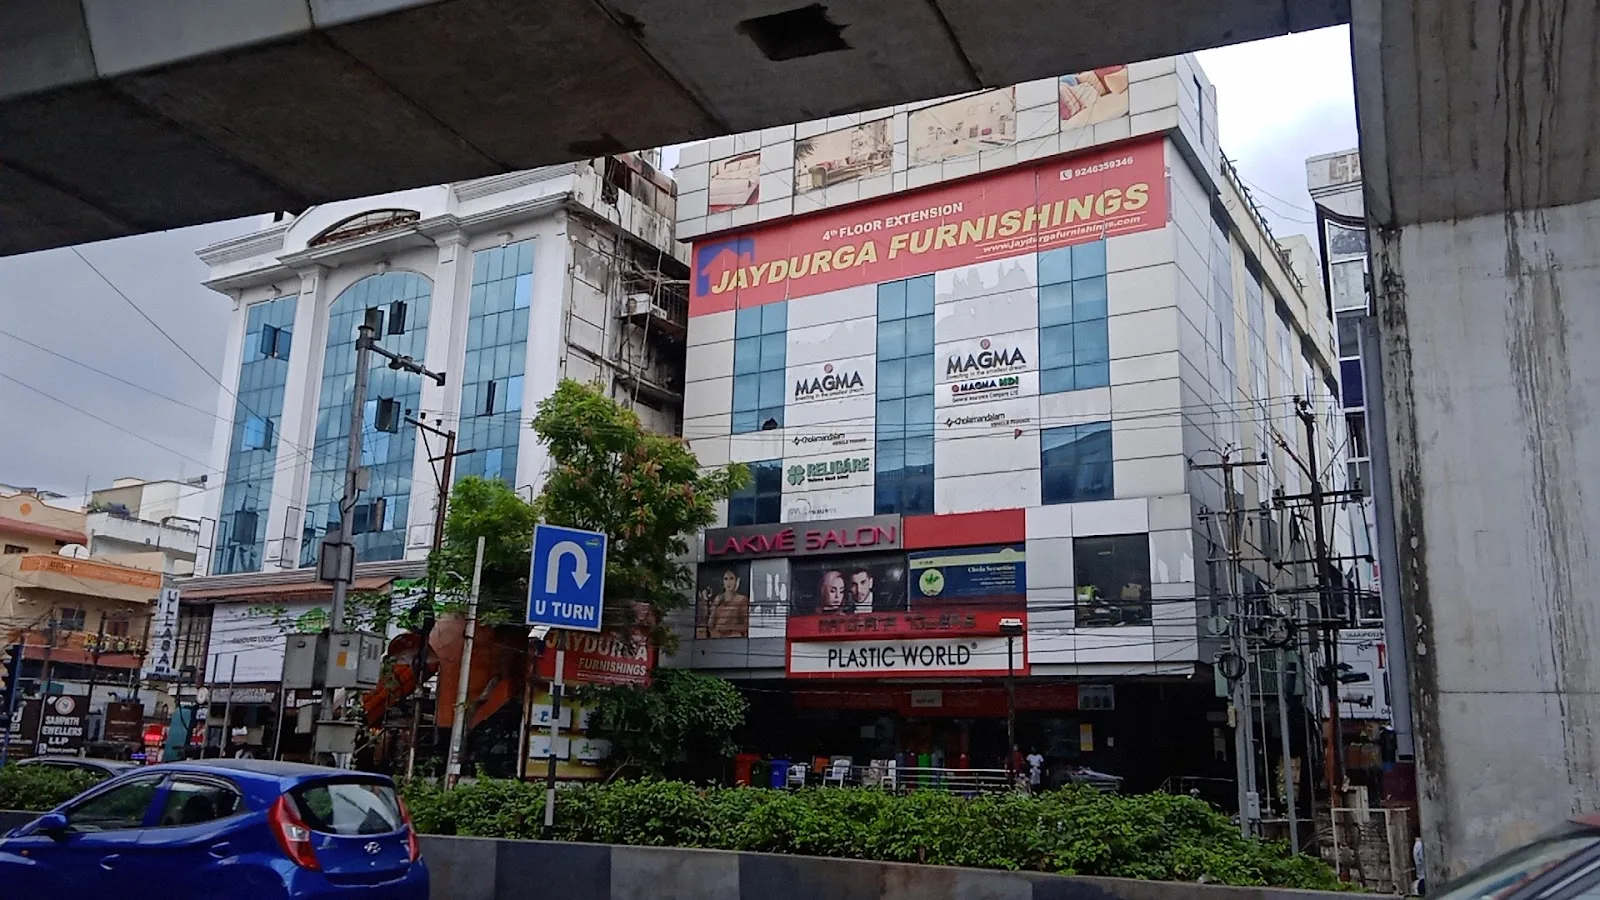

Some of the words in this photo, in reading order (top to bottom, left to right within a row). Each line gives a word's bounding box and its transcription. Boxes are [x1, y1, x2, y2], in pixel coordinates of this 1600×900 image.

[1074, 156, 1134, 177] 9246359346
[822, 229, 838, 241] 4th
[839, 219, 882, 238] FLOOR
[885, 202, 964, 229] EXTENSION
[711, 241, 877, 294] JAYDURGA
[888, 183, 1149, 259] FURNISHINGS
[946, 347, 1027, 374] MAGMA
[795, 371, 864, 396] MAGMA
[961, 379, 997, 391] MAGMA
[709, 526, 796, 556] LAKMÉ
[805, 525, 895, 550] SALON
[535, 600, 546, 616] U
[552, 602, 595, 621] TURN
[158, 590, 178, 665] ULLASA
[579, 658, 647, 676] FURNISHINGS
[828, 645, 896, 668] PLASTIC
[45, 715, 80, 726] SAMPATH
[48, 736, 70, 745] LLP
